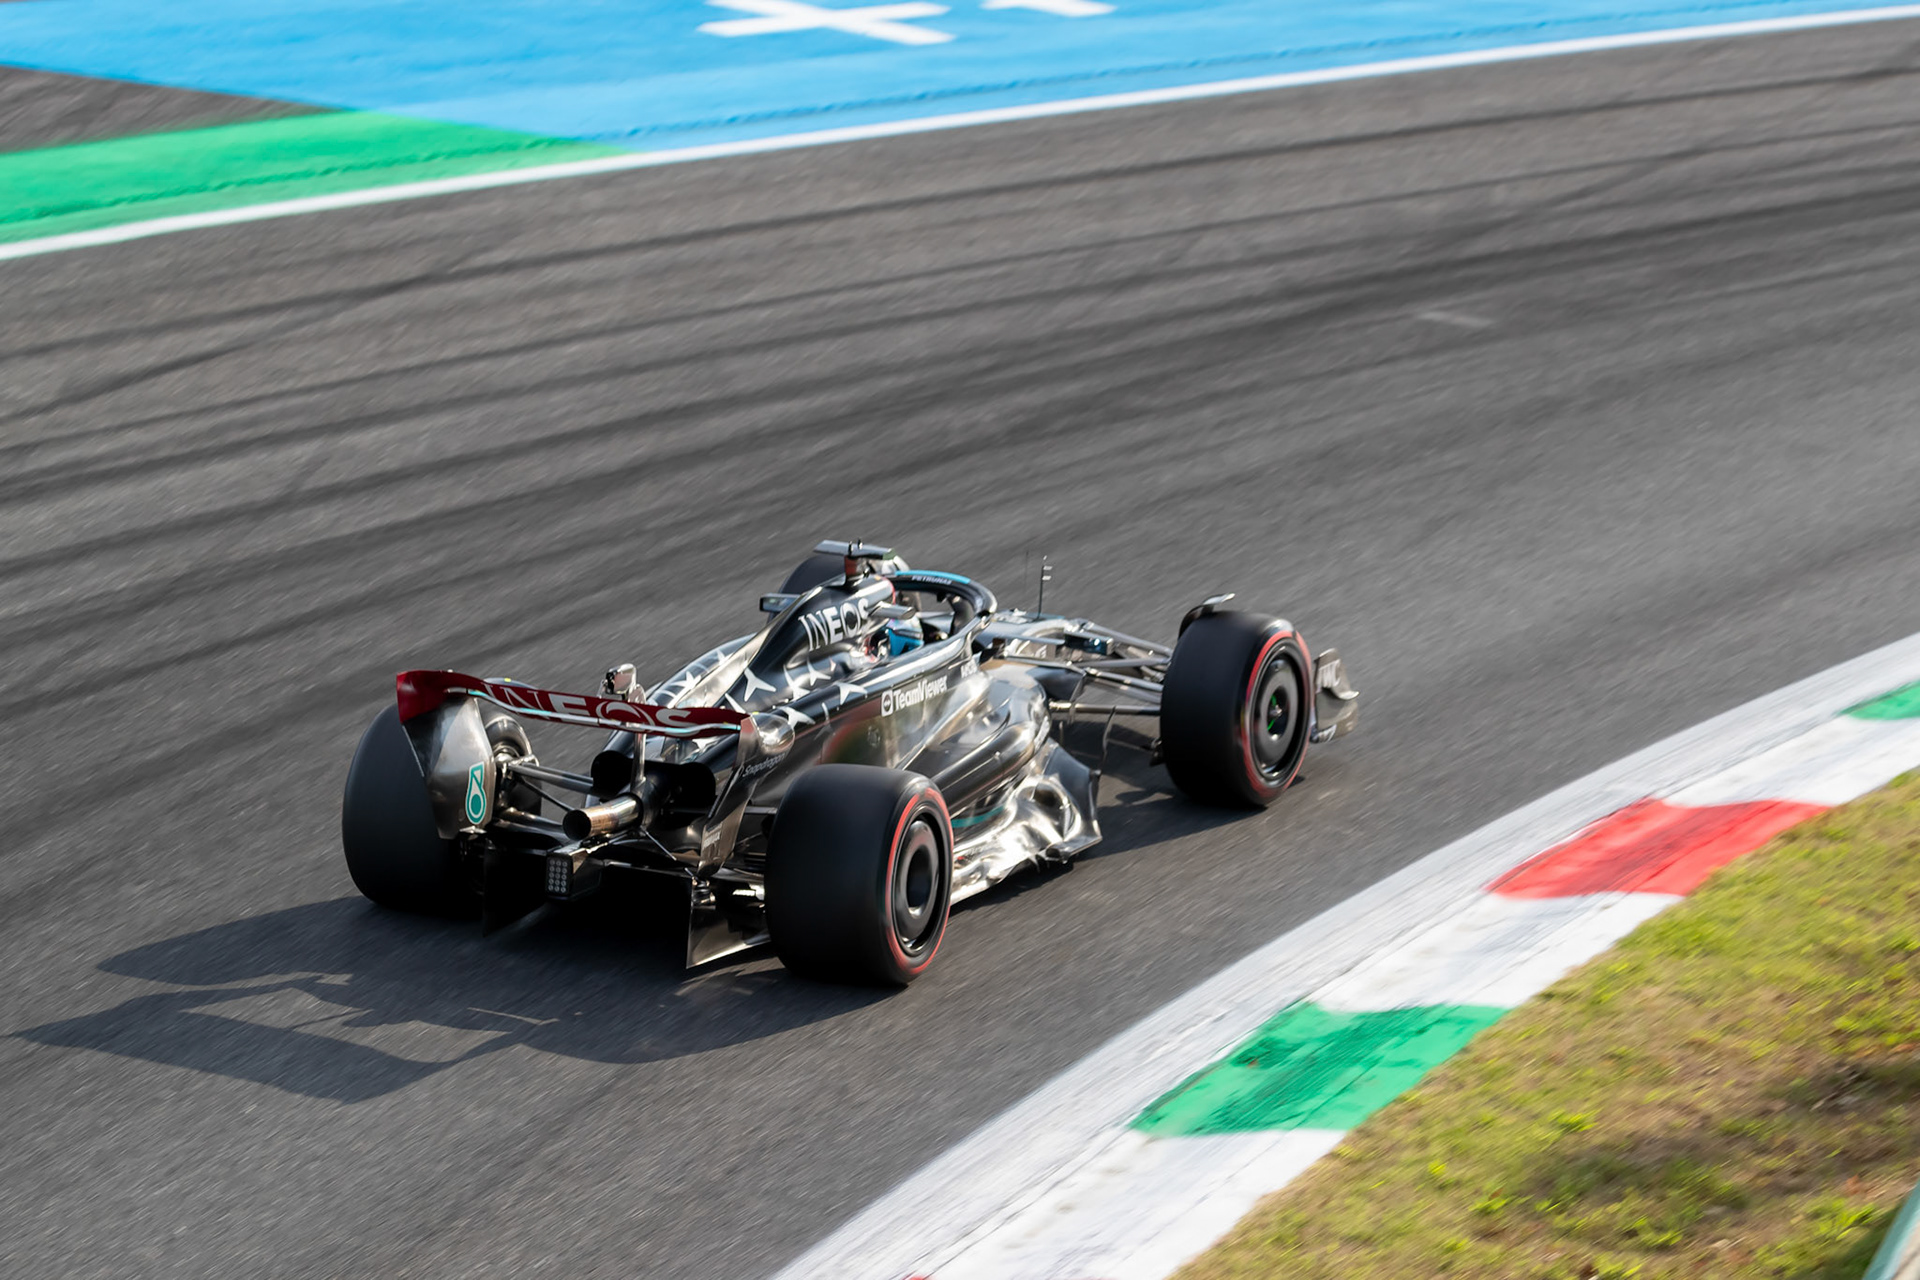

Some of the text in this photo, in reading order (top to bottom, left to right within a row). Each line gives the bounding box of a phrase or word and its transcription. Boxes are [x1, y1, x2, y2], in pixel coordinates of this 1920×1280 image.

[911, 575, 953, 585] PETRONAS
[893, 675, 948, 712] TeamViewer
[483, 682, 701, 738] INEOS
[742, 753, 786, 777] Snapdragon
